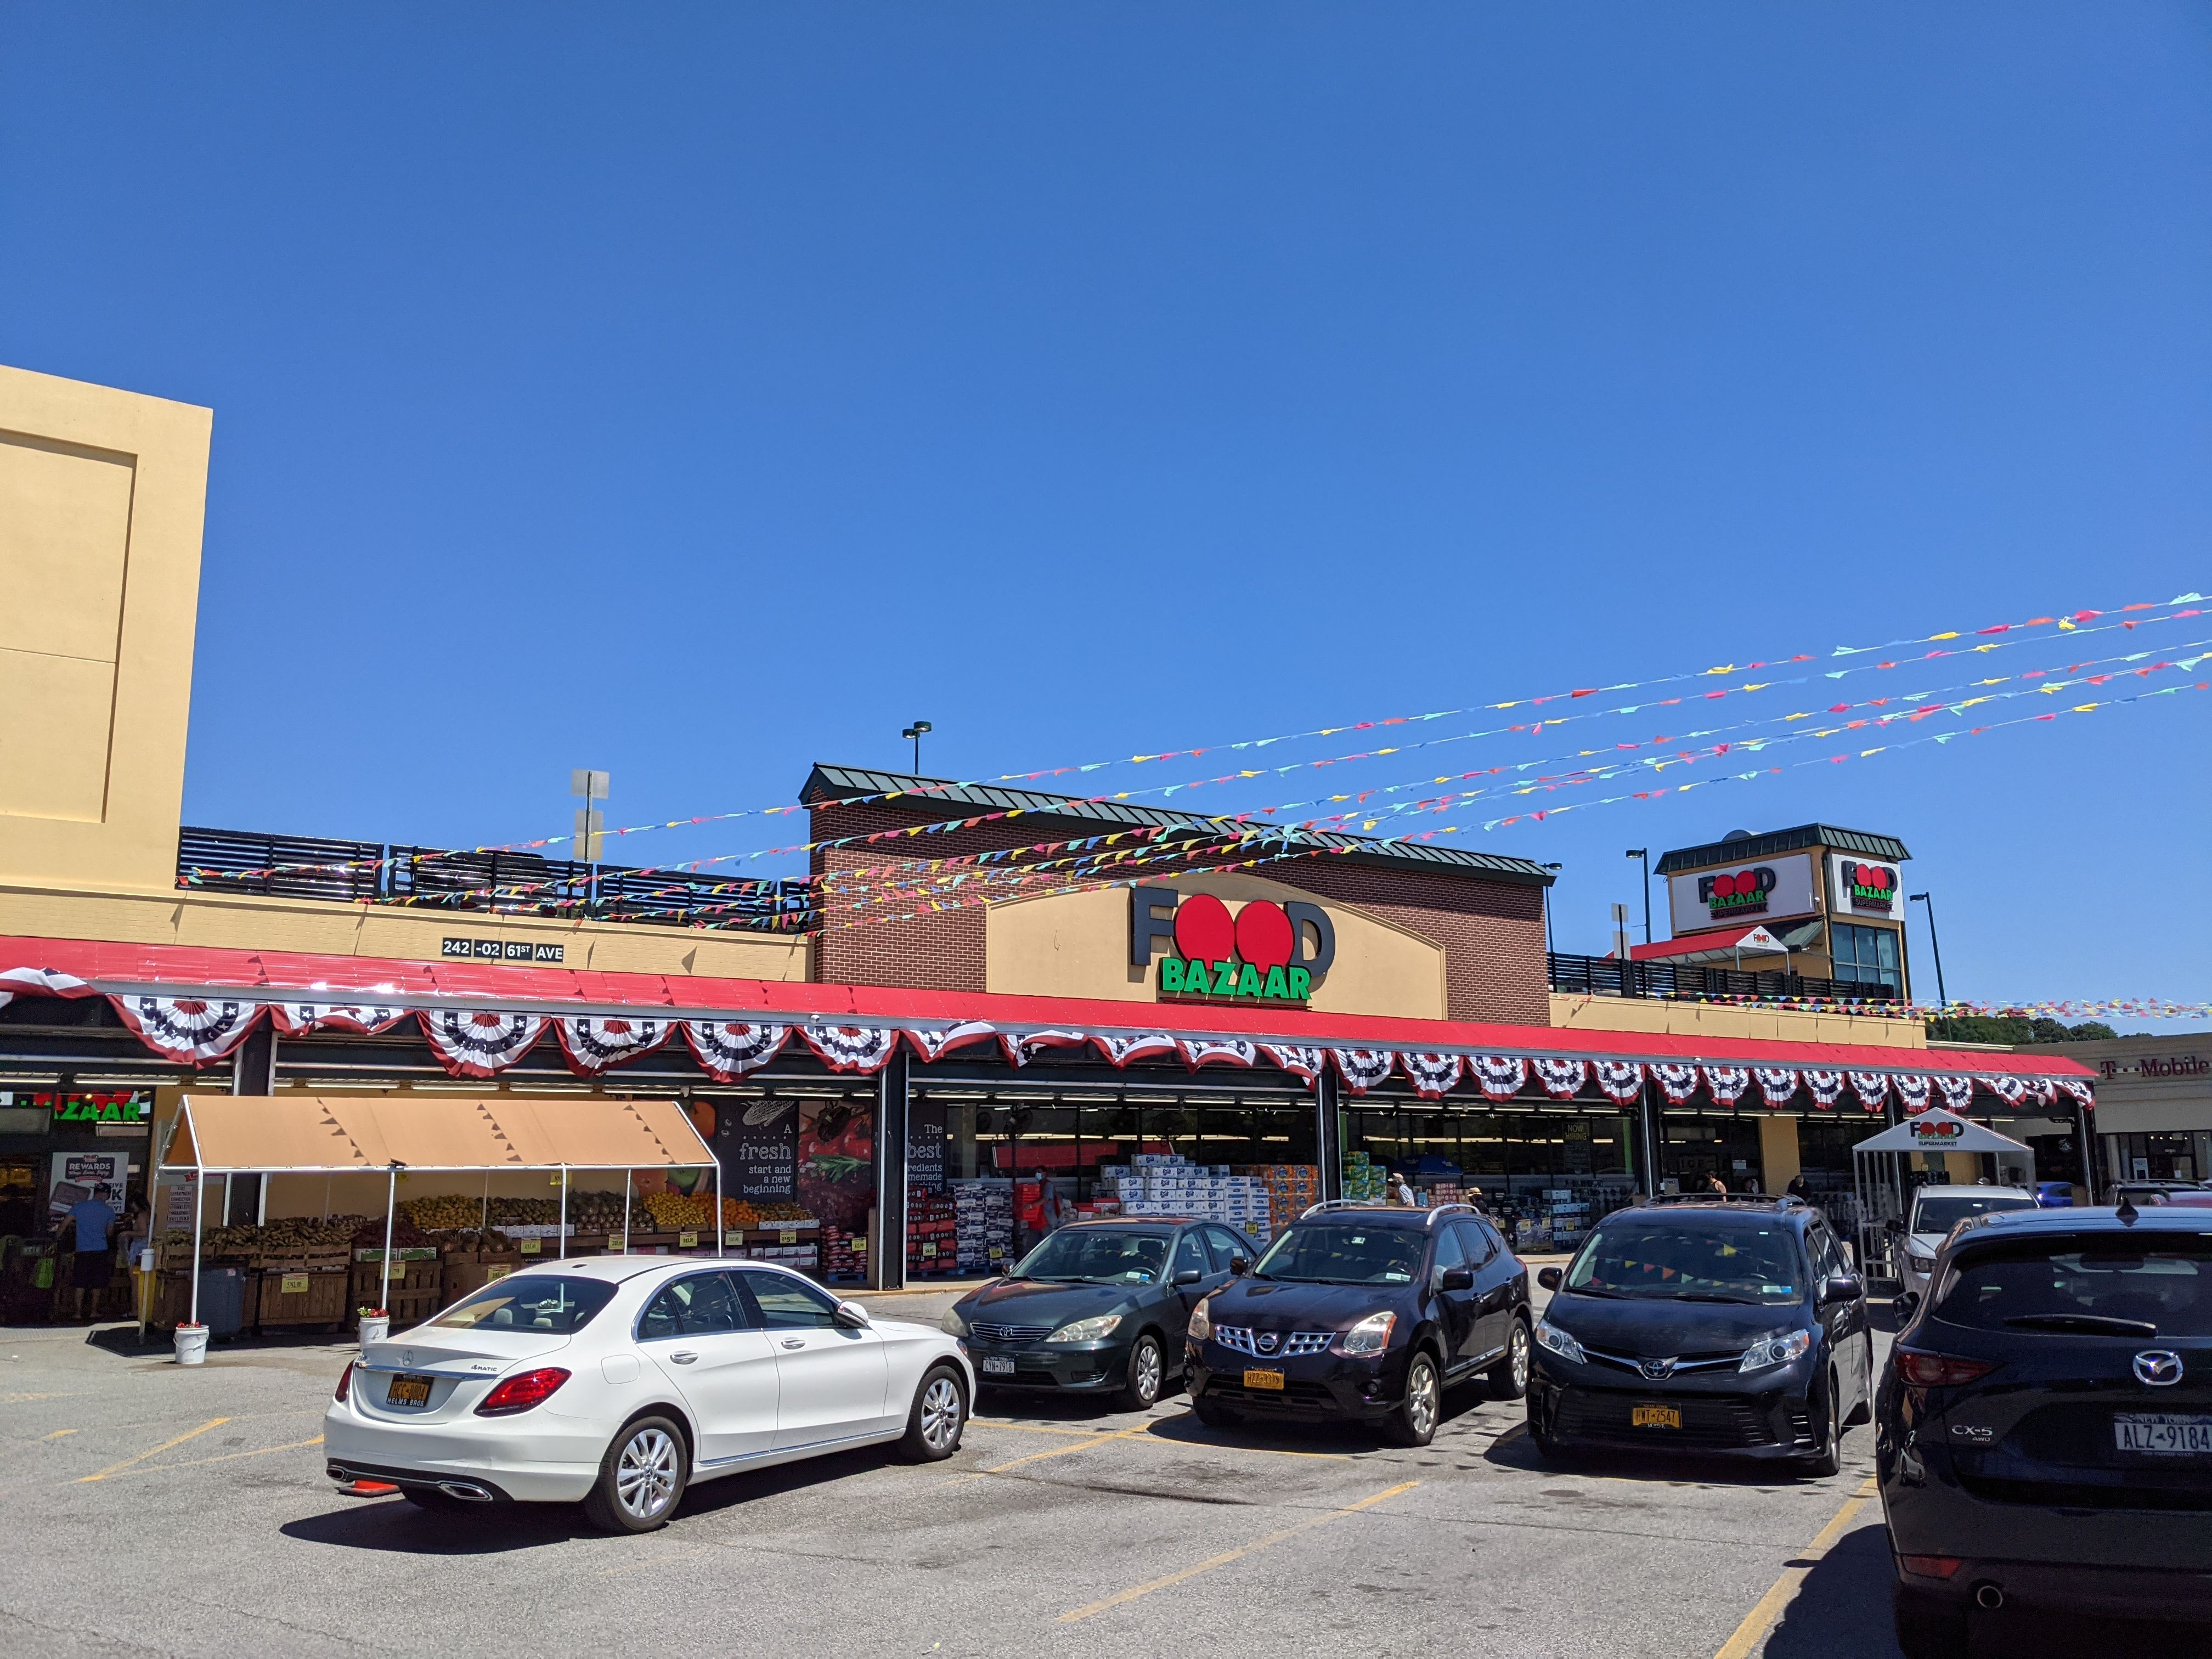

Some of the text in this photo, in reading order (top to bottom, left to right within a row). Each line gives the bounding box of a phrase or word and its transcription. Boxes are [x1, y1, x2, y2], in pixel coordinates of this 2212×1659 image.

[1841, 860, 1898, 893] FOOD
[1698, 867, 1776, 903] FOOD
[1854, 884, 1893, 900] BAZAAR
[1709, 890, 1765, 909] BAZAAR
[1131, 886, 1335, 978] FOOD
[443, 941, 469, 953] 242
[537, 947, 563, 959] AVE
[1160, 957, 1312, 1000] BAZAAR
[783, 1124, 792, 1133] A
[924, 1124, 943, 1133] The
[1568, 1124, 1583, 1132] NOW
[1910, 1122, 1964, 1137] FOOD
[740, 1143, 792, 1160] fresh
[907, 1142, 941, 1158] best
[749, 1165, 791, 1173] start and
[907, 1164, 943, 1172] redients
[907, 1172, 942, 1181] memade
[743, 1184, 791, 1194] beginning
[387, 1397, 407, 1405] HELMS
[2164, 1415, 2191, 1425] YORK
[1952, 1425, 1993, 1436] CX-5
